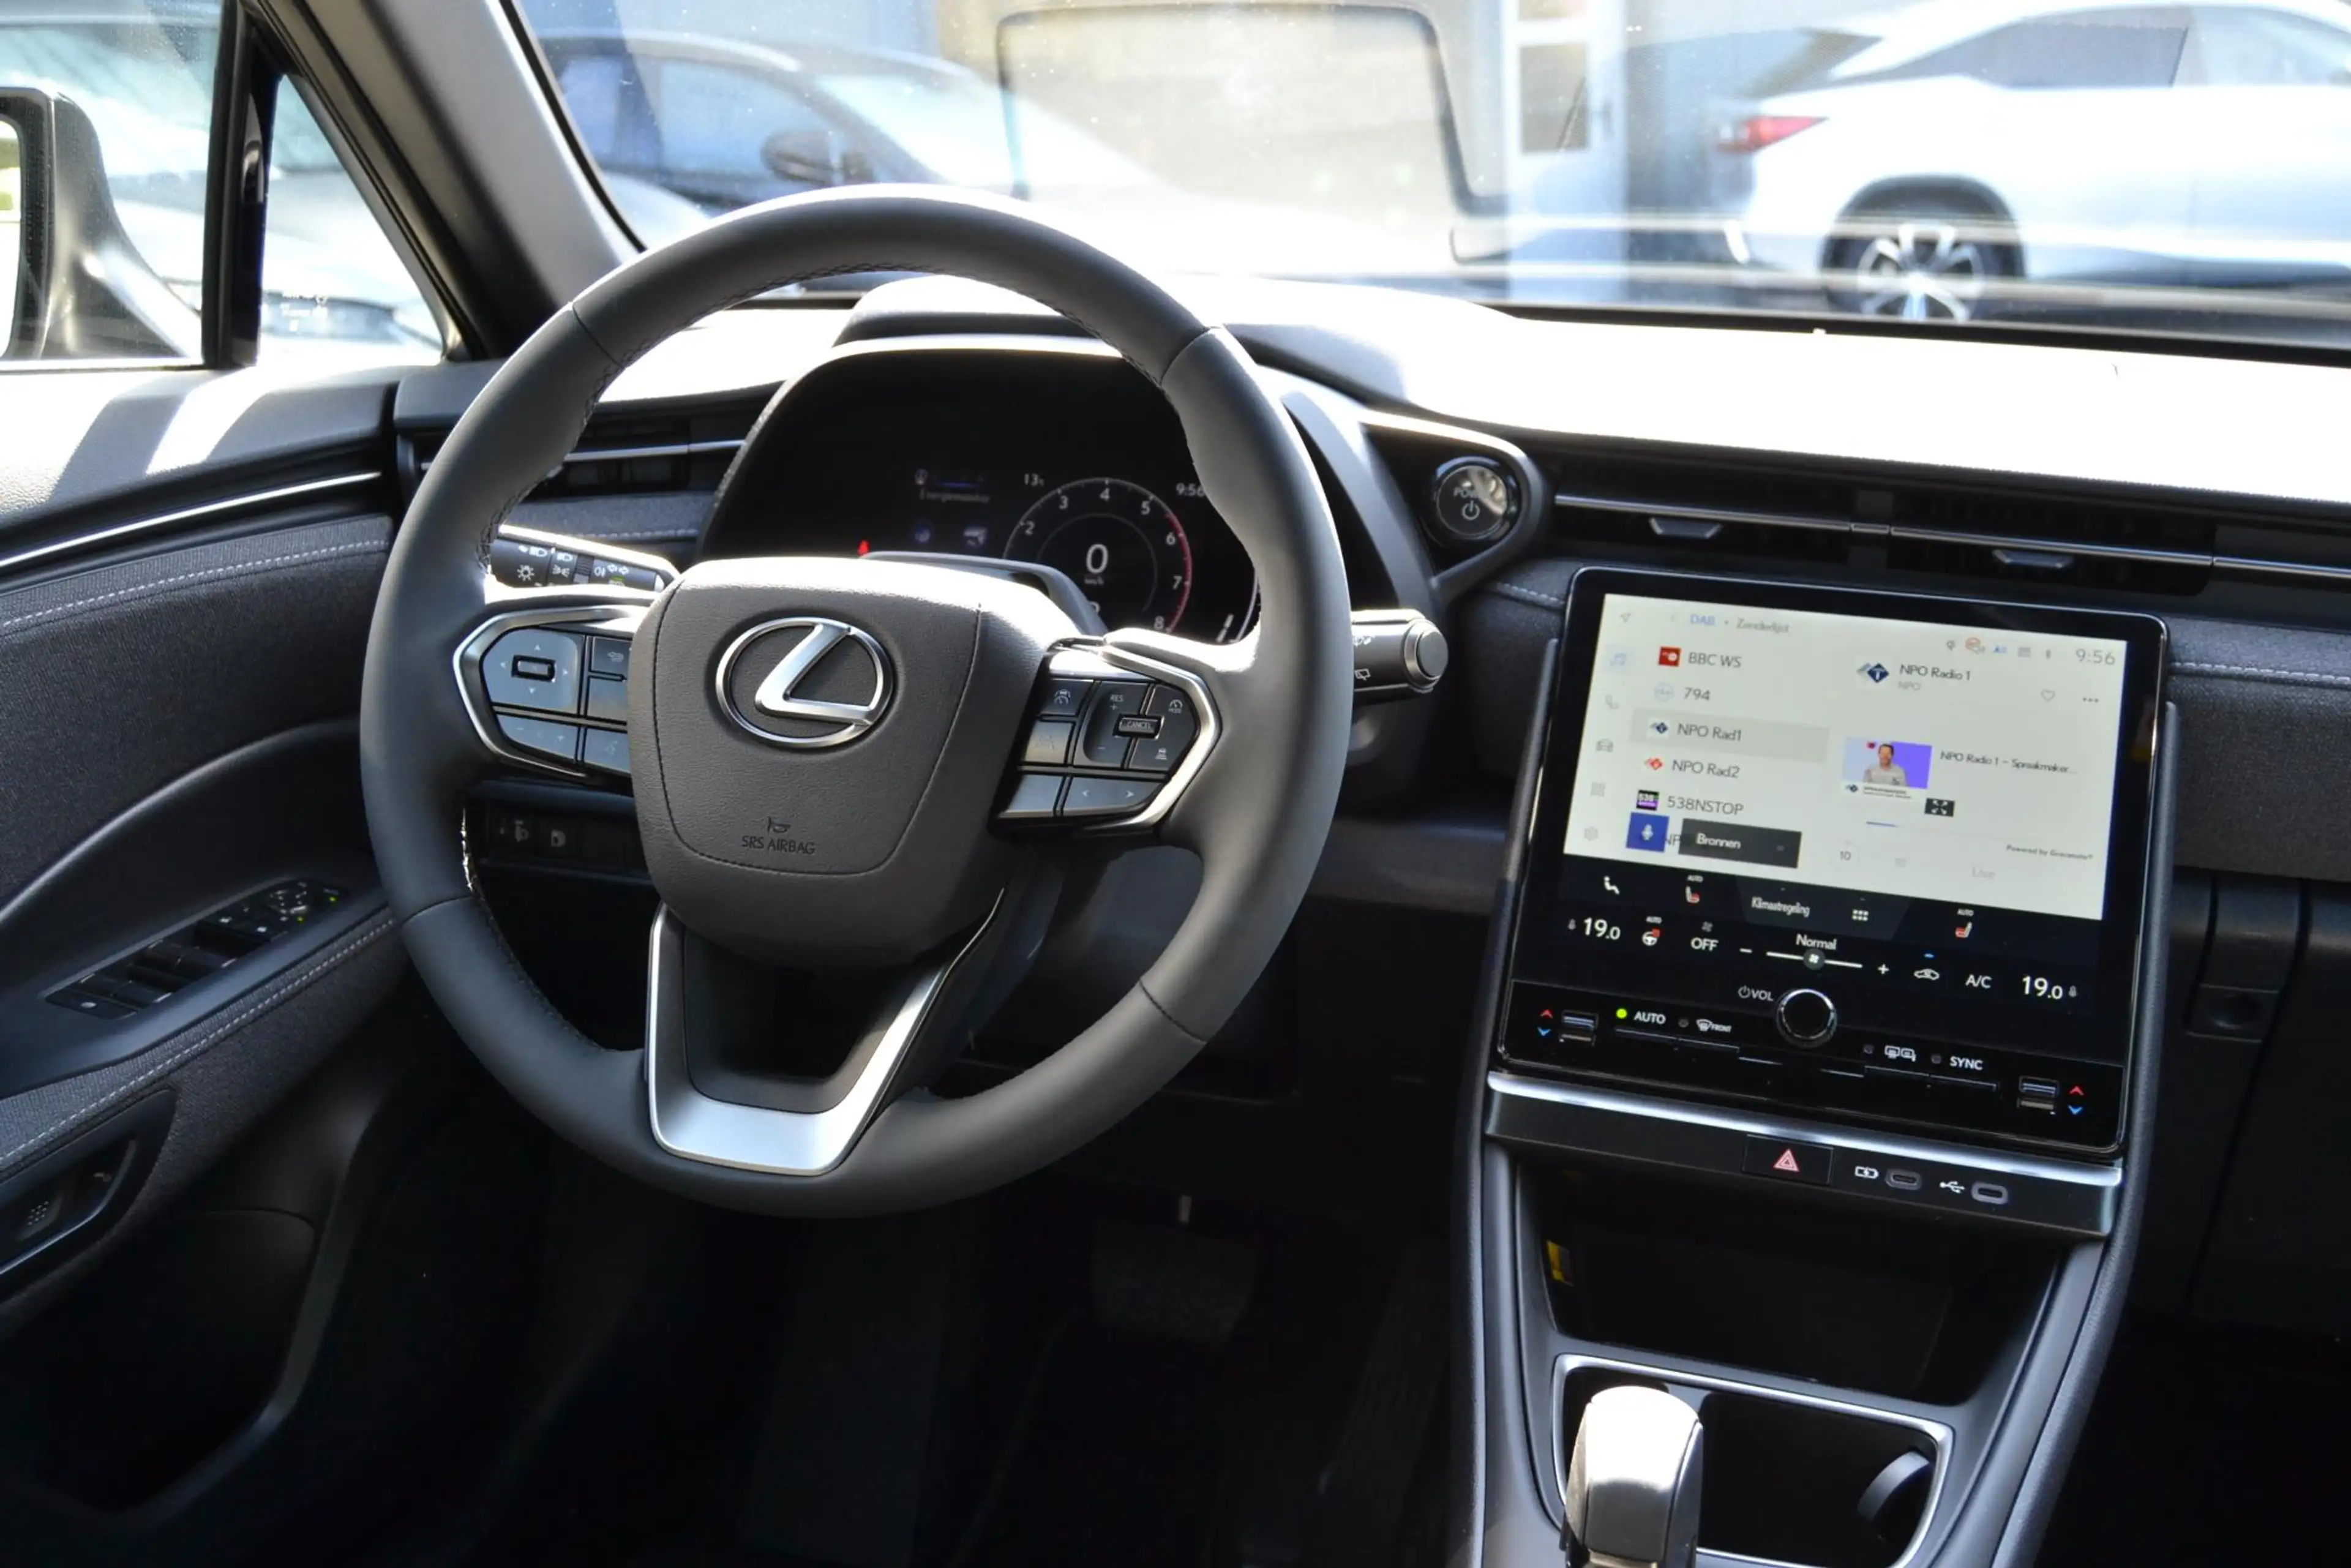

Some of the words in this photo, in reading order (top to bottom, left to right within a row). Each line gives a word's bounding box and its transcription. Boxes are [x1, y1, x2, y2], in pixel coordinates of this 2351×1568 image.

[1059, 495, 1068, 509] 3
[1100, 488, 1111, 501] 4
[1141, 501, 1150, 515] 5
[1024, 521, 1035, 535] 2
[1166, 532, 1176, 545] 6
[1086, 543, 1109, 574] 0
[1173, 575, 1182, 590] 7
[1154, 615, 1164, 630] 8
[1690, 613, 1715, 626] DAB
[1688, 651, 1717, 666] BBC
[1720, 655, 1742, 668] WS
[2075, 648, 2116, 666] 9:56
[1899, 663, 1929, 677] NPO
[1930, 666, 1963, 681] Radio
[1965, 670, 1971, 681] 1
[1109, 694, 1124, 703] RES
[1684, 687, 1711, 701] 794
[1677, 722, 1709, 737] NPO
[1712, 726, 1742, 741] Rad1
[1940, 749, 1964, 762] NPO
[1966, 753, 1992, 765] Radio
[1672, 759, 1704, 775] NPO
[1707, 762, 1740, 778] Rad2
[1667, 795, 1744, 816] 538NSTOP
[741, 835, 764, 850] SRS
[767, 838, 816, 855] AIRBAG
[1696, 832, 1741, 849] Bronnen
[1840, 850, 1852, 861] 10
[1687, 874, 1704, 883] AUTO
[1646, 916, 1663, 925] AUTO
[1957, 909, 1974, 917] AUTO
[1584, 917, 1621, 940] 19.0
[1690, 937, 1719, 951] OFF
[1795, 933, 1838, 951] Normal
[1965, 973, 1992, 989] A/C
[2022, 975, 2063, 1000] 19.0
[1751, 989, 1774, 1002] VOL
[1633, 1010, 1667, 1025] AUTO
[1949, 1055, 1984, 1071] SYNC
